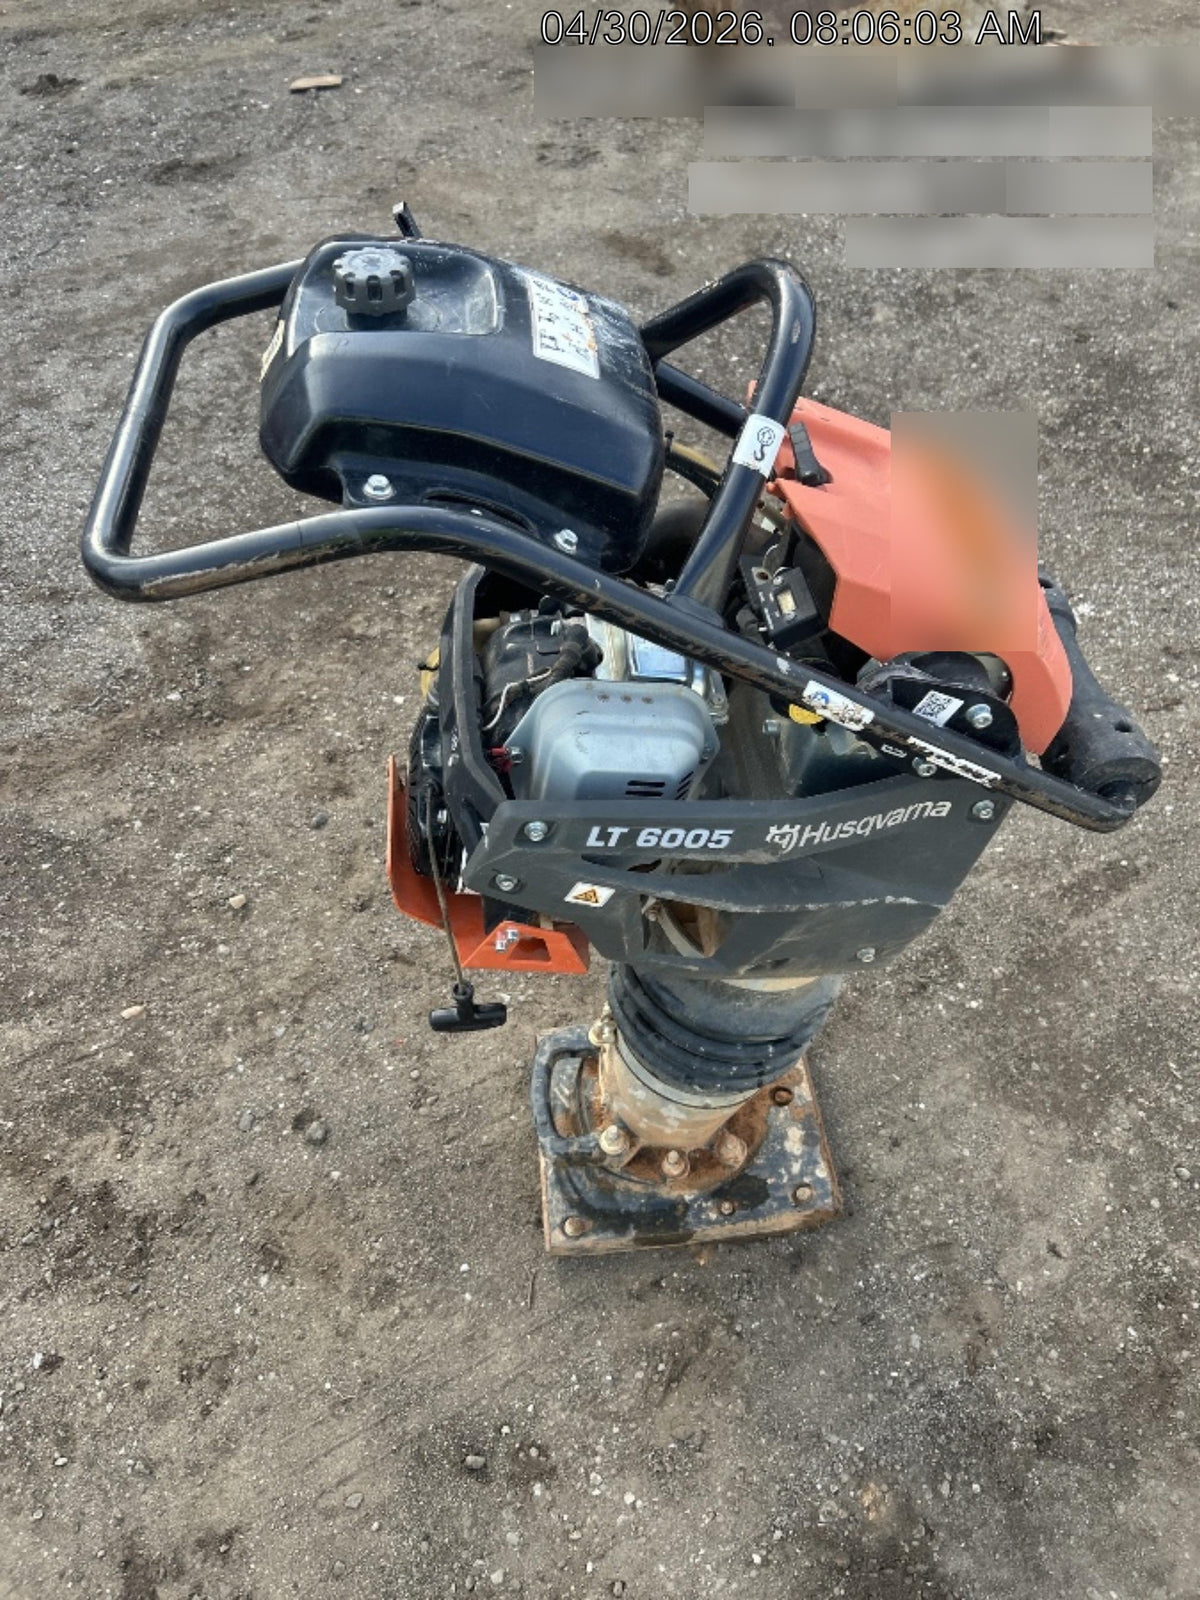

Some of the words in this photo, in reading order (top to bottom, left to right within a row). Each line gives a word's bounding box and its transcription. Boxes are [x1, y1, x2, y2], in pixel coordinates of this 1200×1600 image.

[799, 800, 952, 838] Husqvarna
[586, 825, 630, 847] LT
[635, 827, 735, 849] 6005
